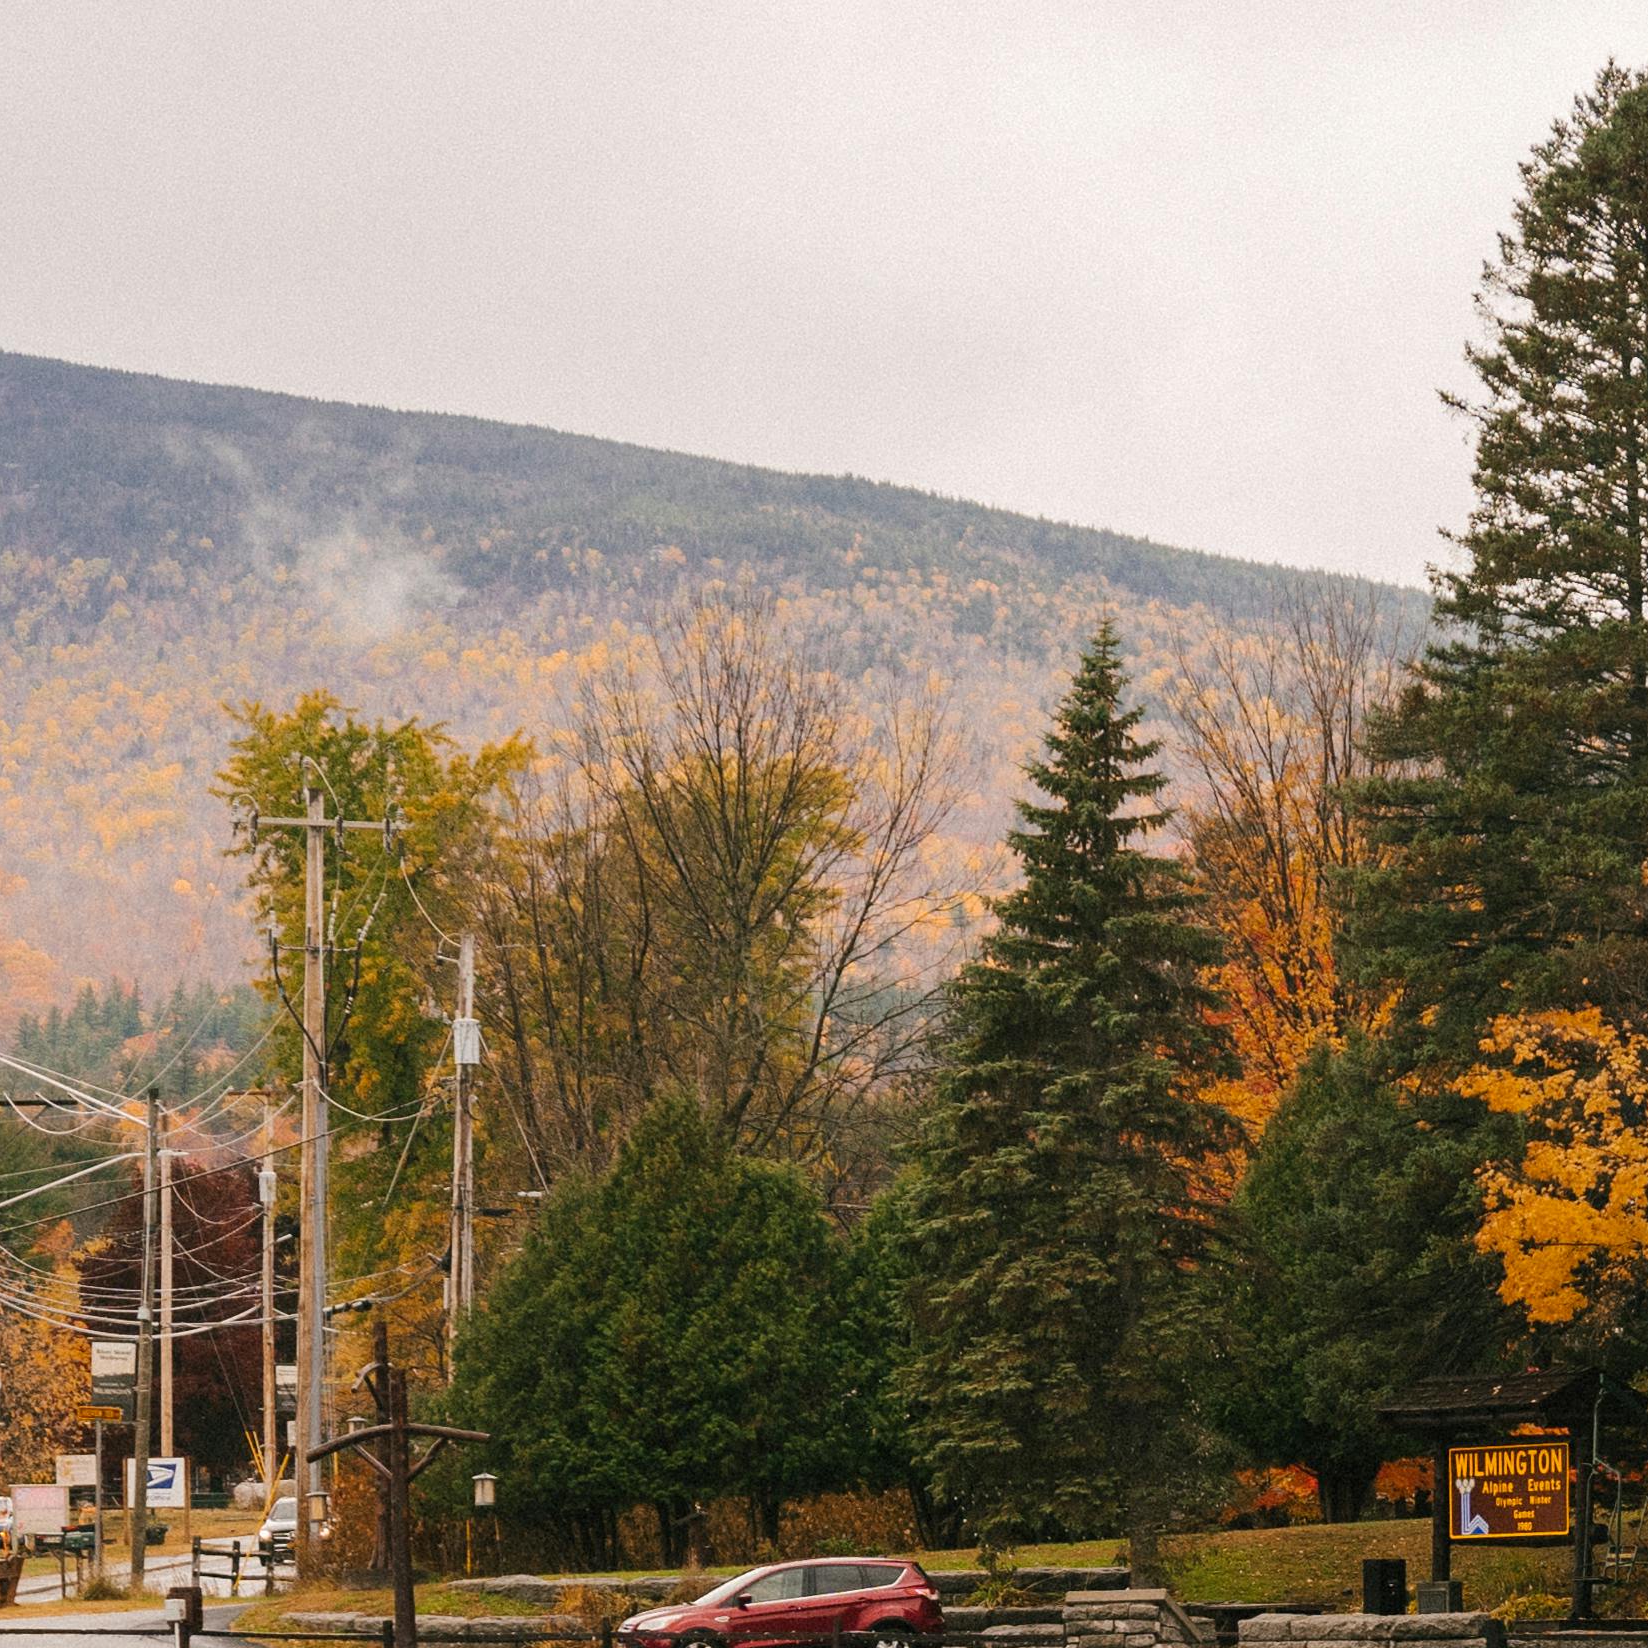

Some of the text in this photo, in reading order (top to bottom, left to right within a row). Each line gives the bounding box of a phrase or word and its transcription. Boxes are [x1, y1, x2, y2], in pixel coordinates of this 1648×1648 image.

[1454, 1448, 1563, 1477] WILMINGTON
[1482, 1478, 1562, 1496] Alpine Events
[1513, 1509, 1535, 1519] Games
